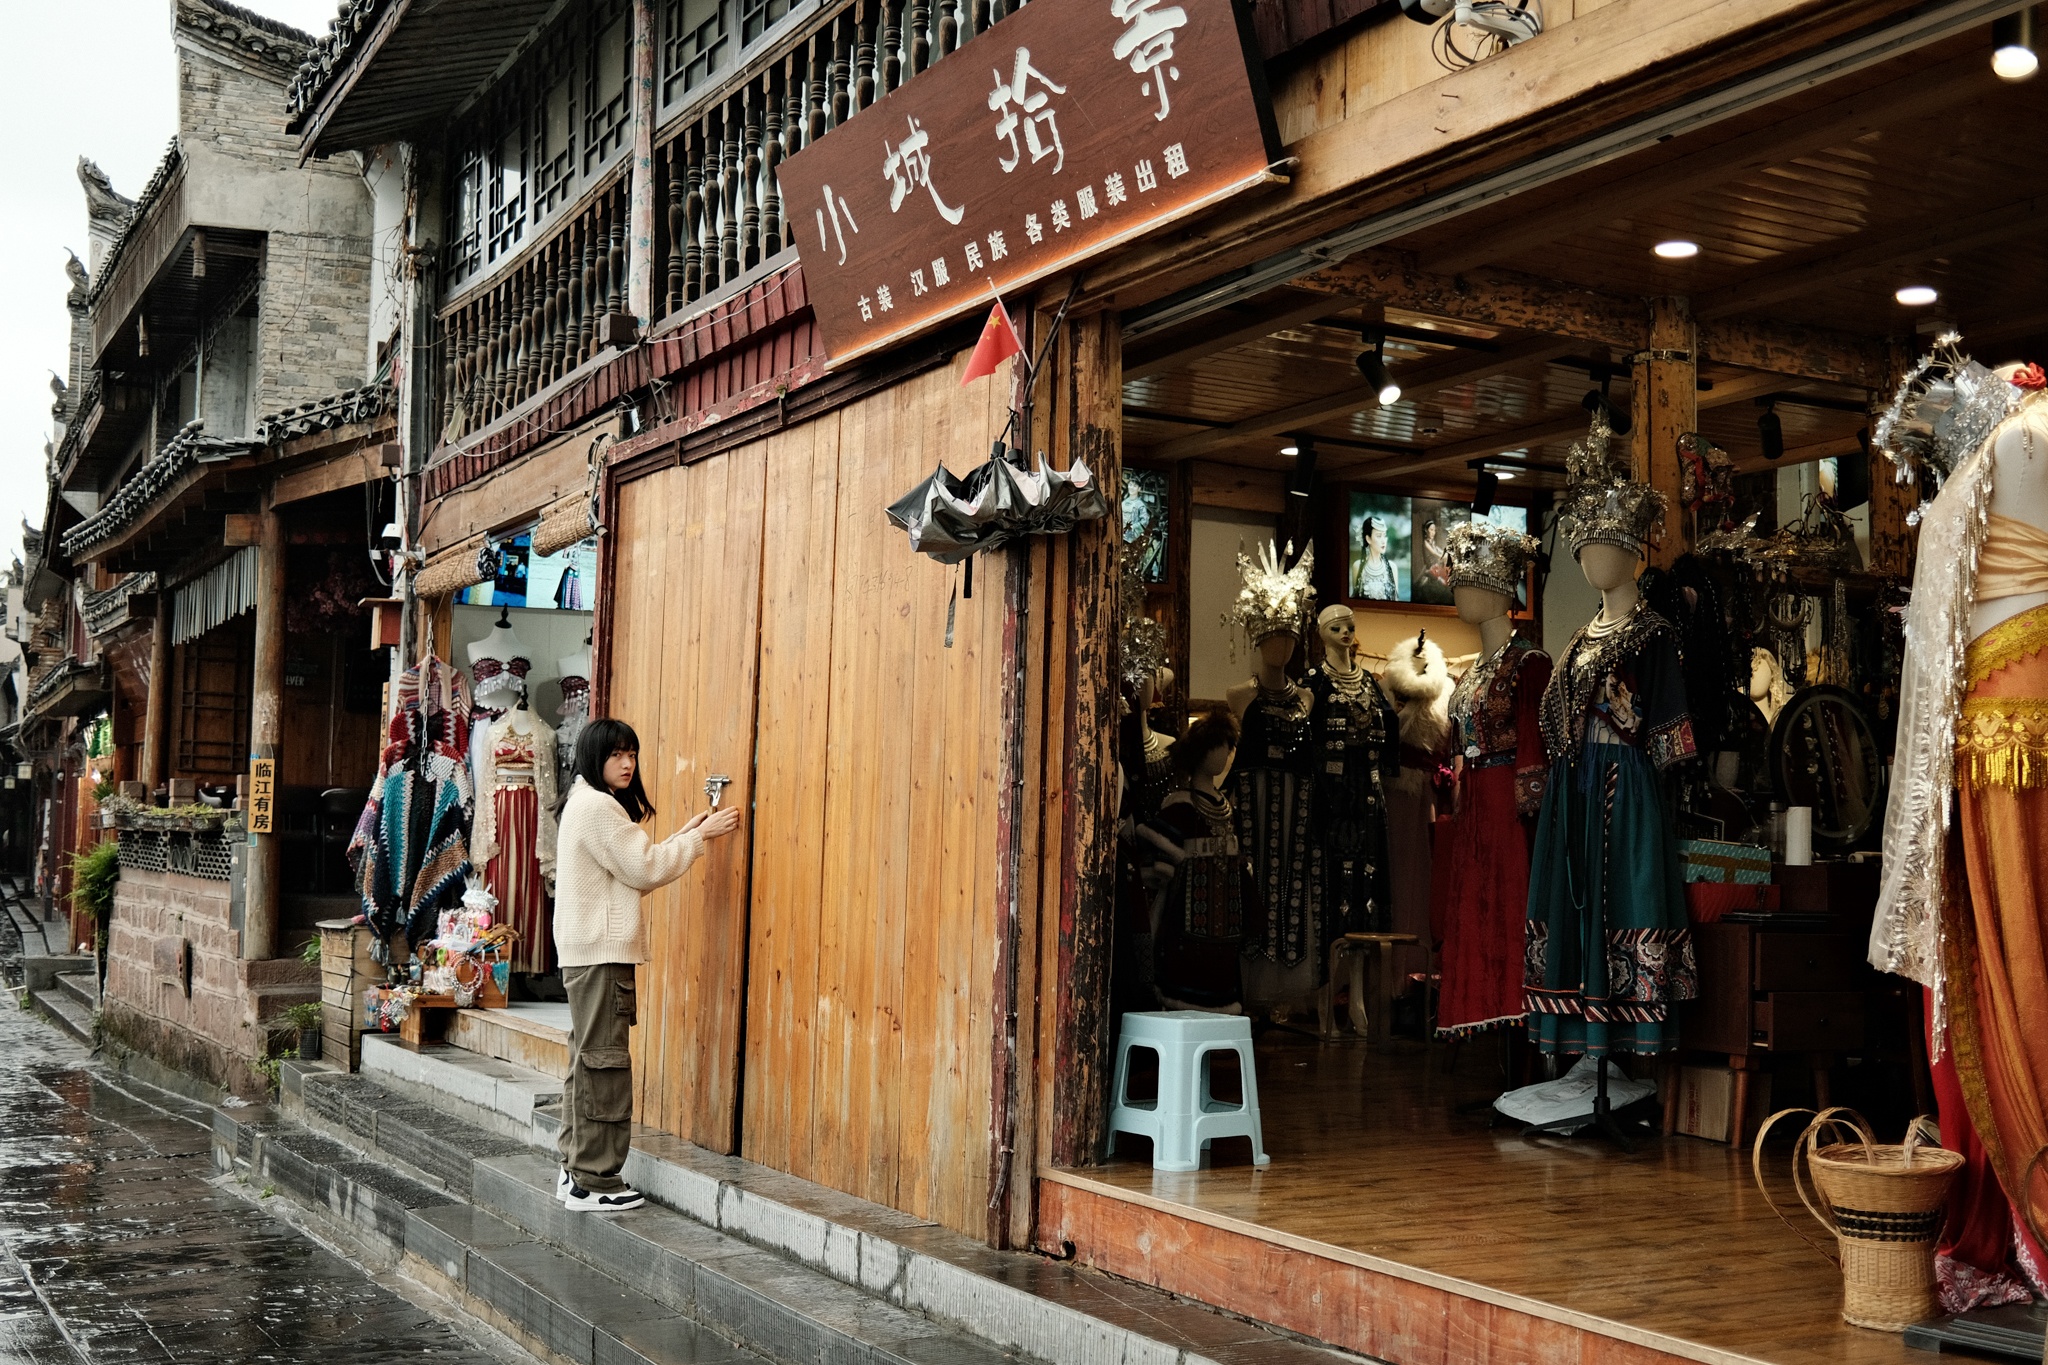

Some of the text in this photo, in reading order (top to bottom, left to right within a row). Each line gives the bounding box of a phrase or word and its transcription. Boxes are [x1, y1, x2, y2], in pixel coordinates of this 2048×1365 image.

[857, 142, 1188, 322] 古装 汉服 民族 各类服装出租
[253, 762, 272, 829] 临江有房
